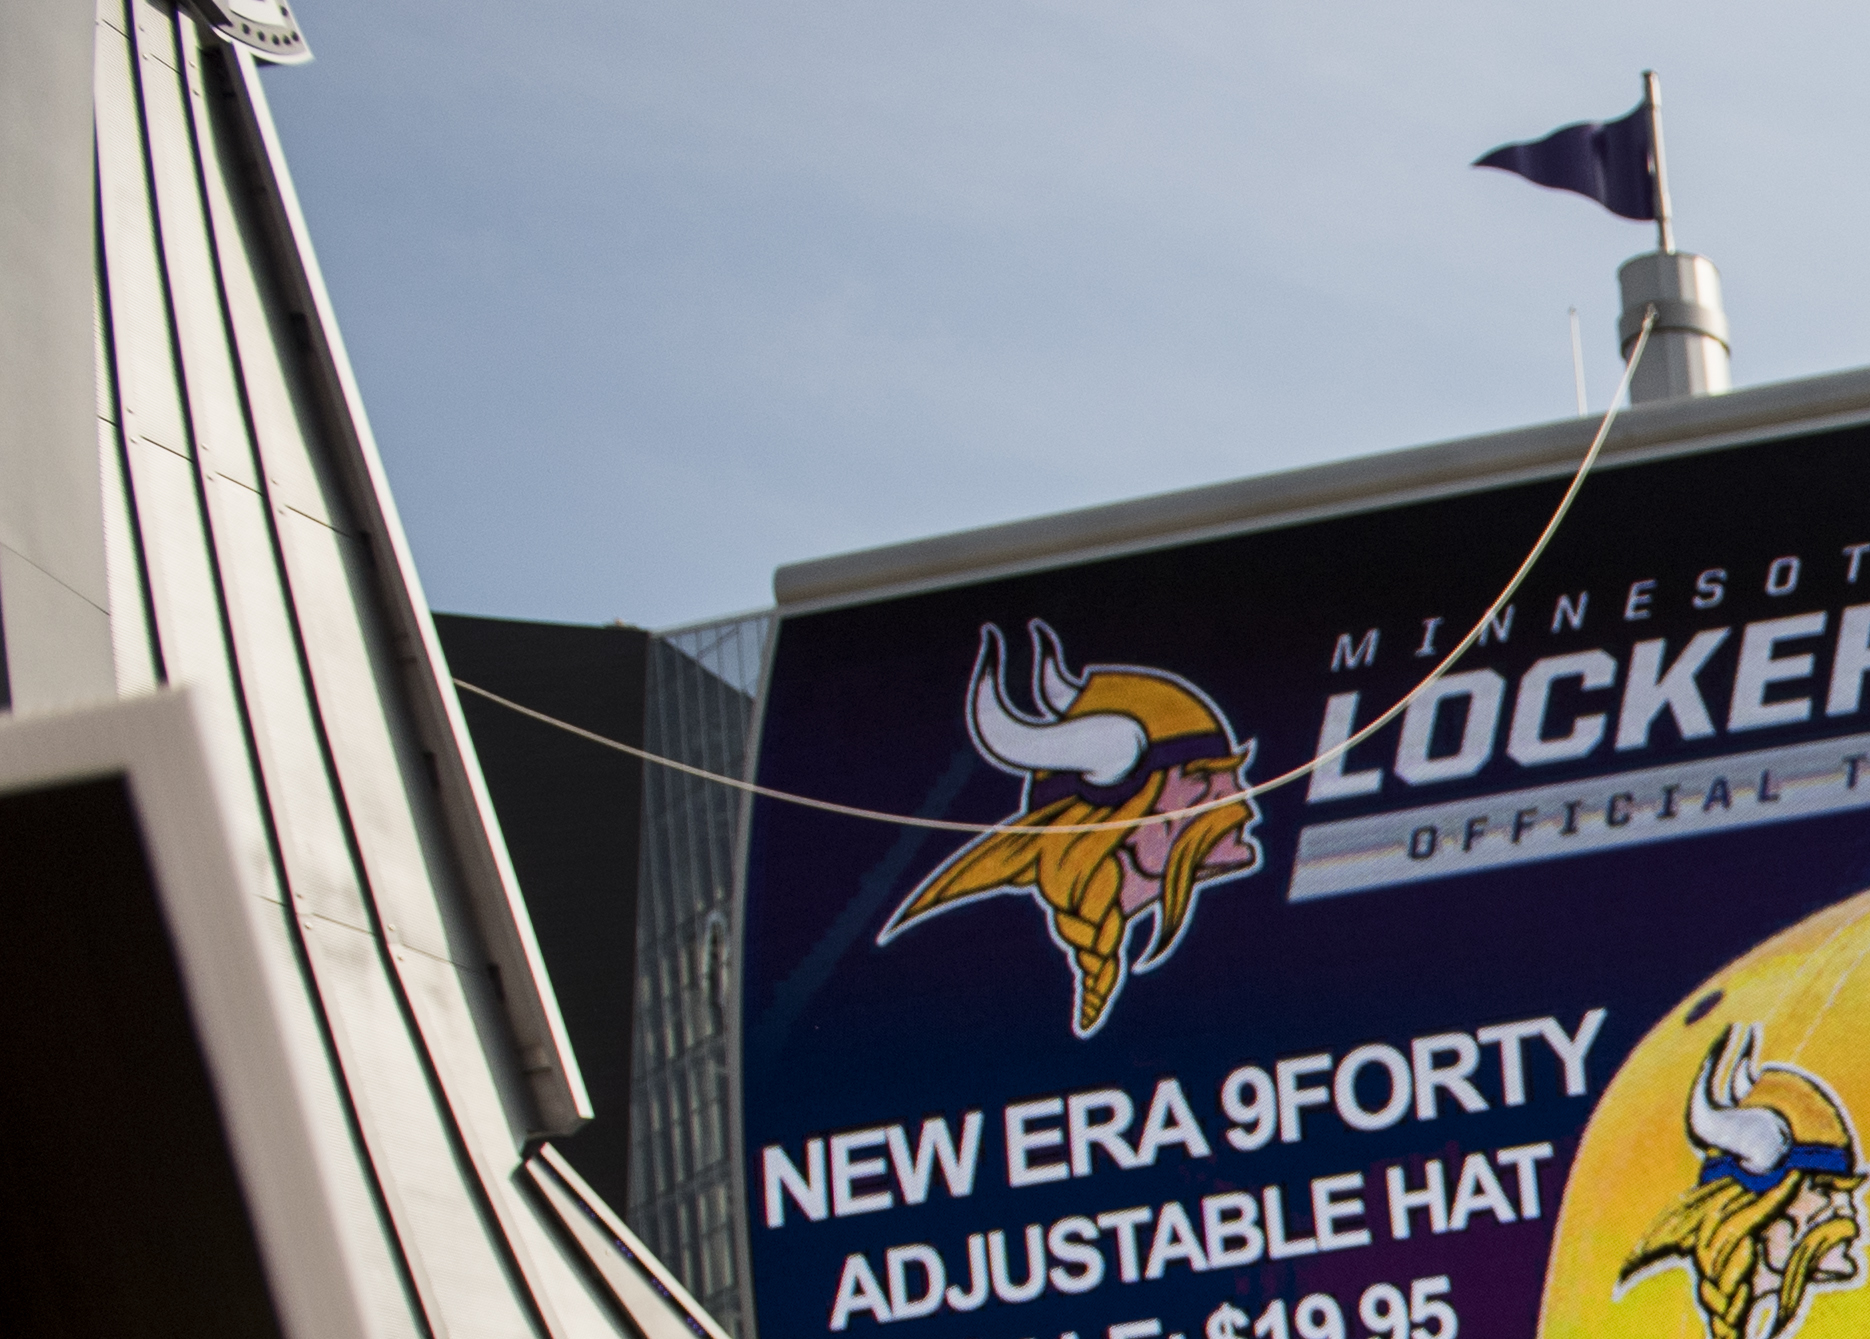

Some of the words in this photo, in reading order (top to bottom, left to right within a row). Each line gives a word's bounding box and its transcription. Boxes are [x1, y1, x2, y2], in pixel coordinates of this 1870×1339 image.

[1404, 766, 1786, 863] OFFICIAL
[762, 1110, 984, 1229] NEW
[1003, 1079, 1211, 1188] ERA
[1218, 1007, 1607, 1151] 9FORTY
[829, 1171, 1373, 1331] ADJUSTABLE
[1387, 1141, 1553, 1240] HAT
